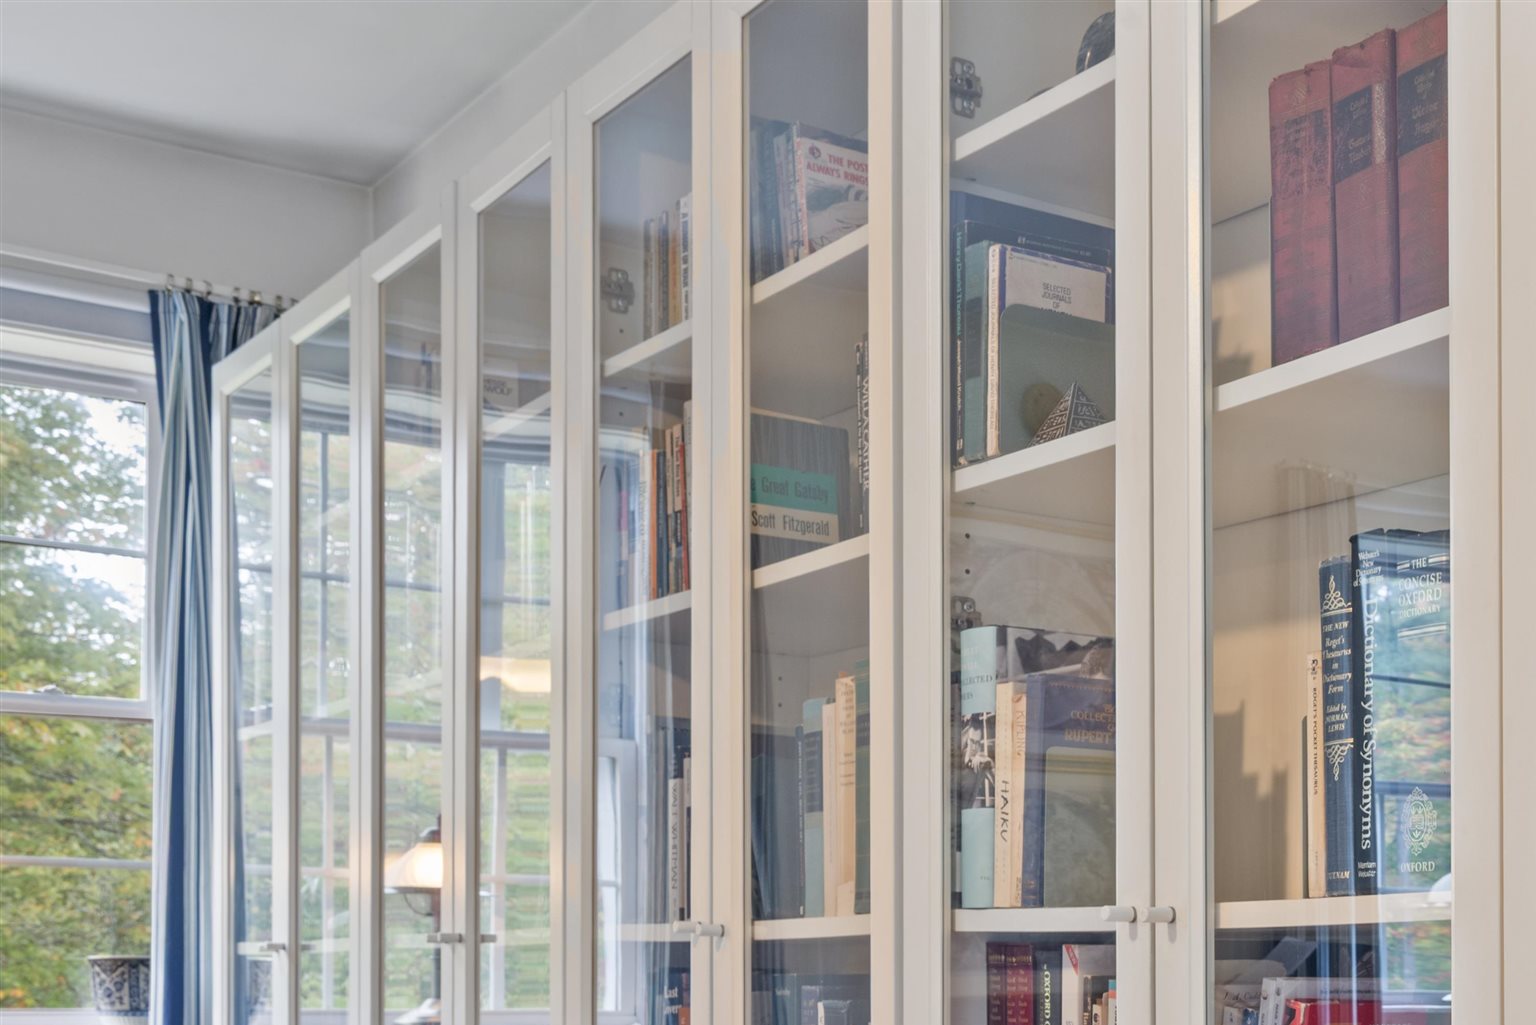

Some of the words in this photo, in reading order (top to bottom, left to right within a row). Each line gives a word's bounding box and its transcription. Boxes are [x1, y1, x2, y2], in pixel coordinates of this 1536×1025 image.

[827, 153, 845, 168] THE
[806, 162, 841, 180] ALWAYS
[1041, 291, 1072, 305] JOURNALS
[1042, 282, 1071, 296] SELECTED
[862, 377, 870, 427] WILLA
[862, 428, 870, 491] CATHER
[761, 477, 789, 497] Great
[793, 482, 830, 505] Gatsby
[751, 510, 777, 531] Scott
[783, 513, 830, 538] Fitzgerald
[1411, 557, 1427, 570] THE
[1398, 572, 1442, 592] CONCISE
[1399, 588, 1442, 606] OXFORD
[1400, 605, 1442, 619] DICTIONARY
[1361, 600, 1378, 708] Dictionary
[1014, 709, 1025, 759] KIPLING
[1359, 739, 1376, 850] Synonyms
[1000, 778, 1010, 844] HAIKU
[1400, 860, 1435, 874] OXFORD
